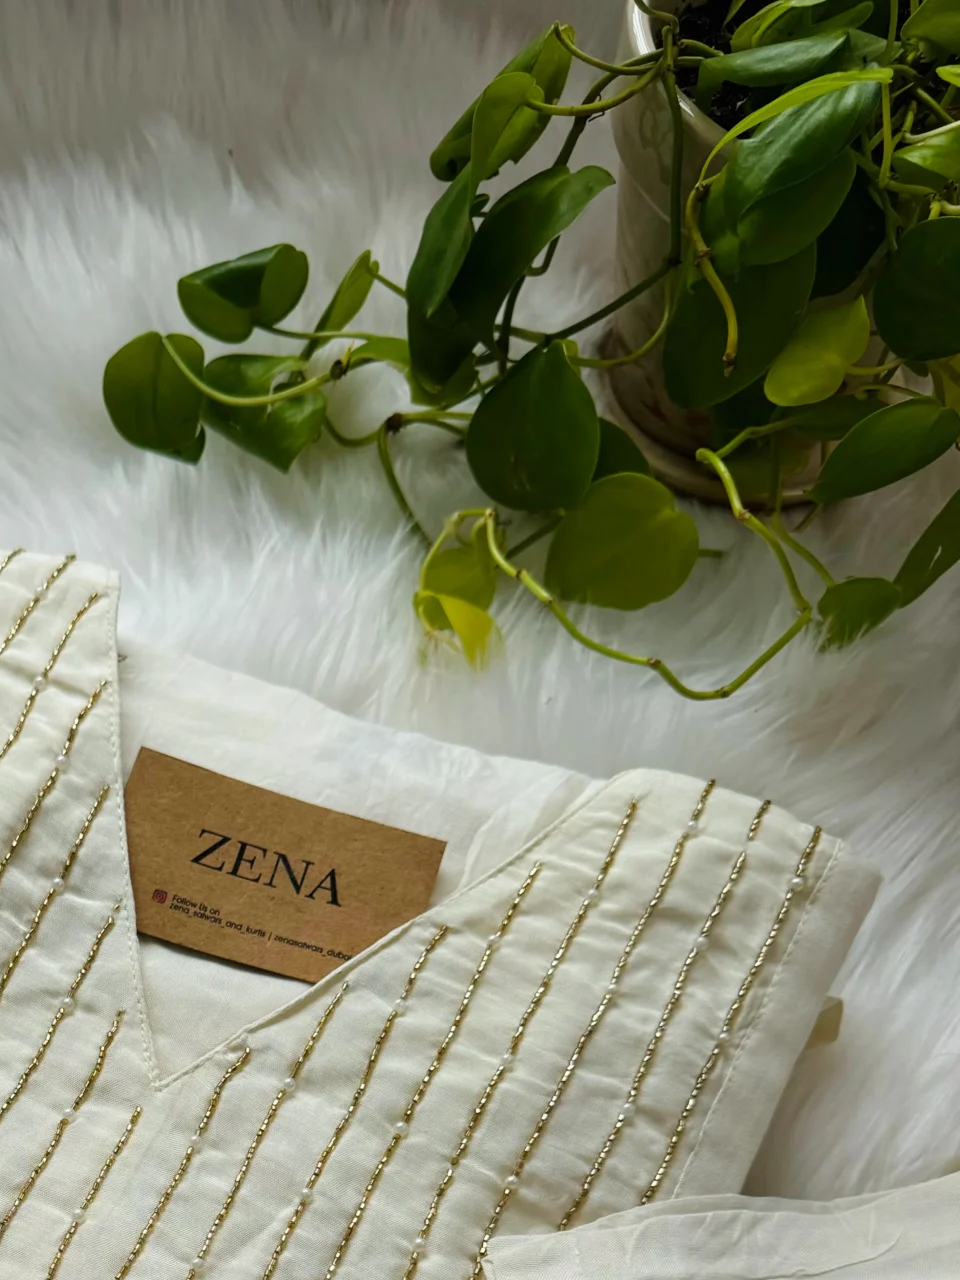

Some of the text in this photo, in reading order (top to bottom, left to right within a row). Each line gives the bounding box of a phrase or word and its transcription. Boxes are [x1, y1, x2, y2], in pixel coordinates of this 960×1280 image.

[190, 828, 342, 908] ZENA
[172, 894, 220, 916] Follow Us on
